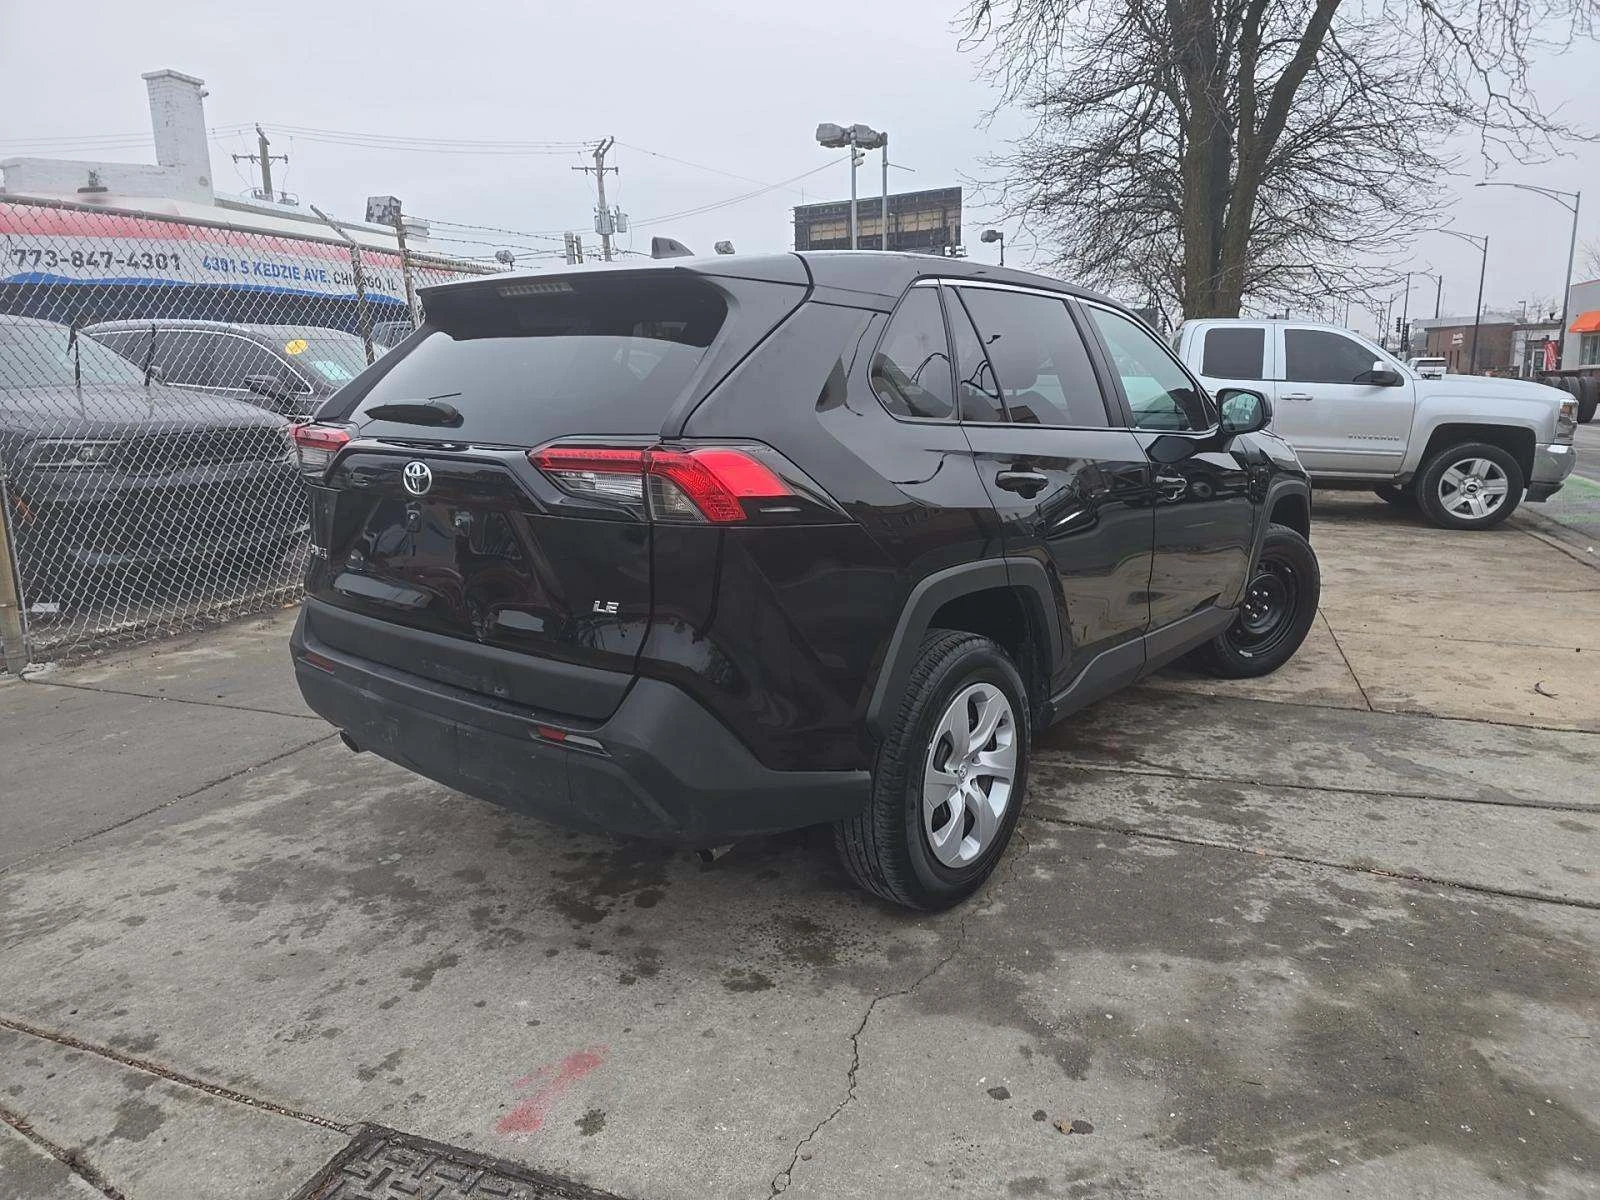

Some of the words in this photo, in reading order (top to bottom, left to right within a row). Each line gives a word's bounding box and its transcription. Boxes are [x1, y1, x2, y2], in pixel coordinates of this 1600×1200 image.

[12, 249, 181, 271] 773-847-4301
[202, 255, 236, 274] 4301
[241, 260, 249, 274] S
[252, 260, 299, 279] KEDZIE
[304, 268, 331, 284] AVE.
[333, 271, 386, 292] CHIAGO,
[387, 277, 398, 291] IL
[592, 600, 619, 614] LE
